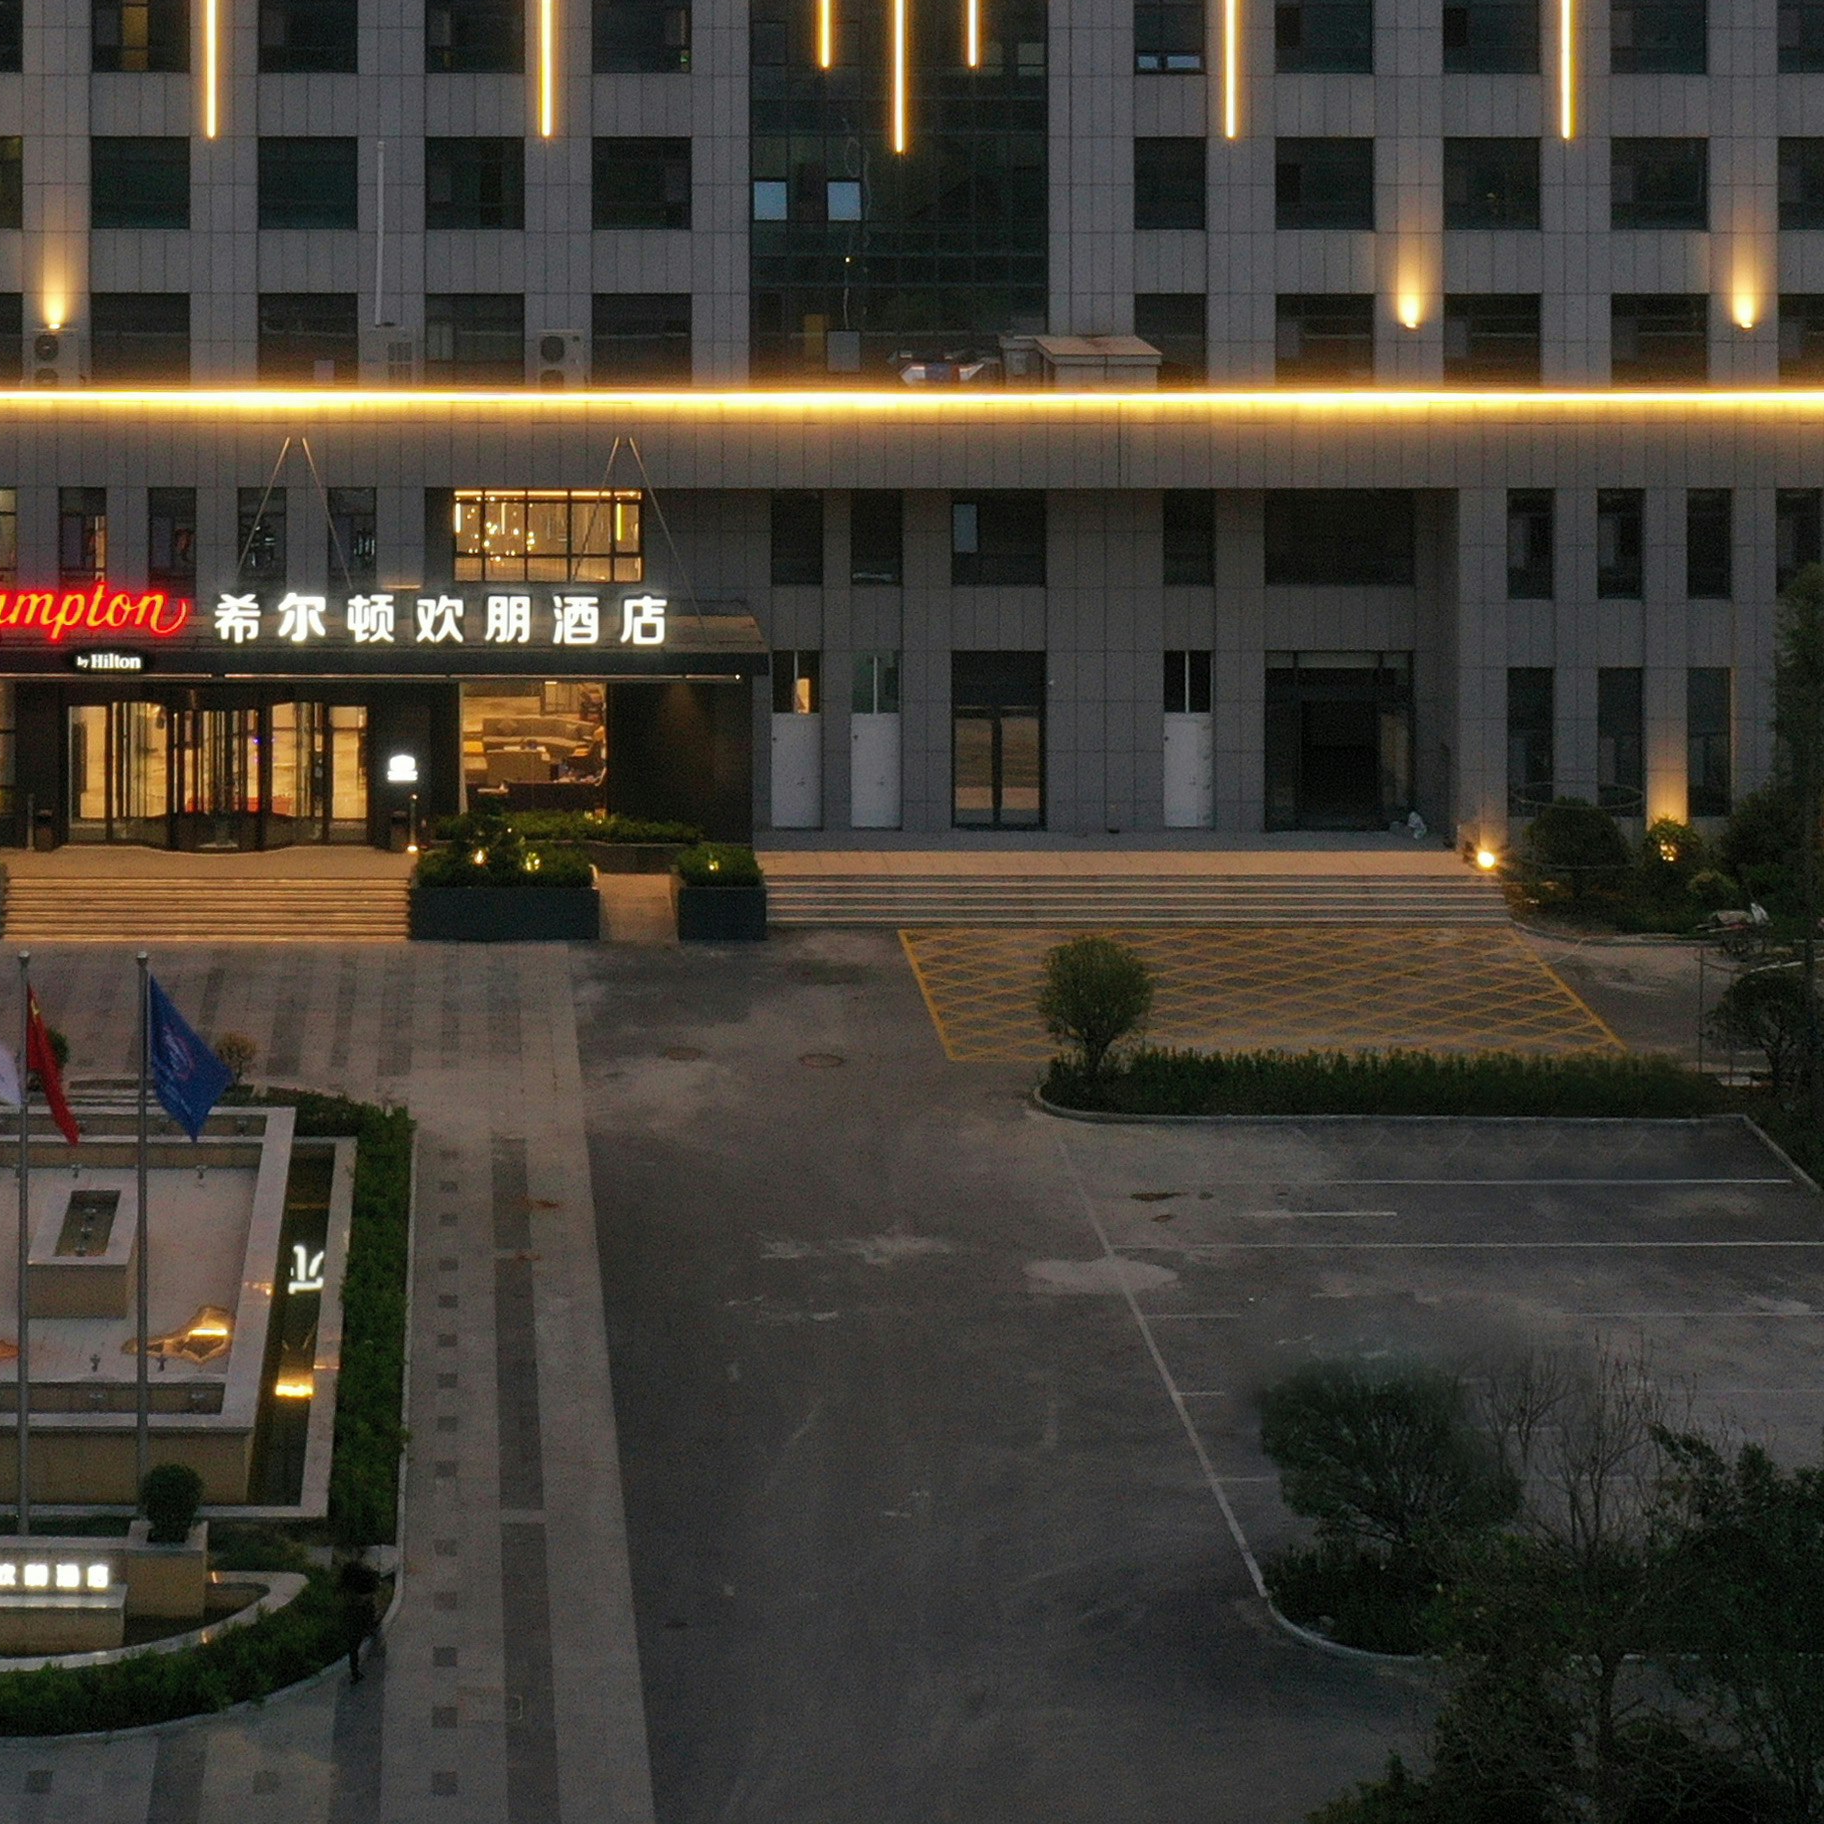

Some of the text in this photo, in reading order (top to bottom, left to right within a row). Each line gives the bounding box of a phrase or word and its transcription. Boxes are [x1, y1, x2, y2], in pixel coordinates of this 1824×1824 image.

[214, 592, 667, 645] 希尔顿欢朋酒店
[90, 652, 142, 669] Hilton
